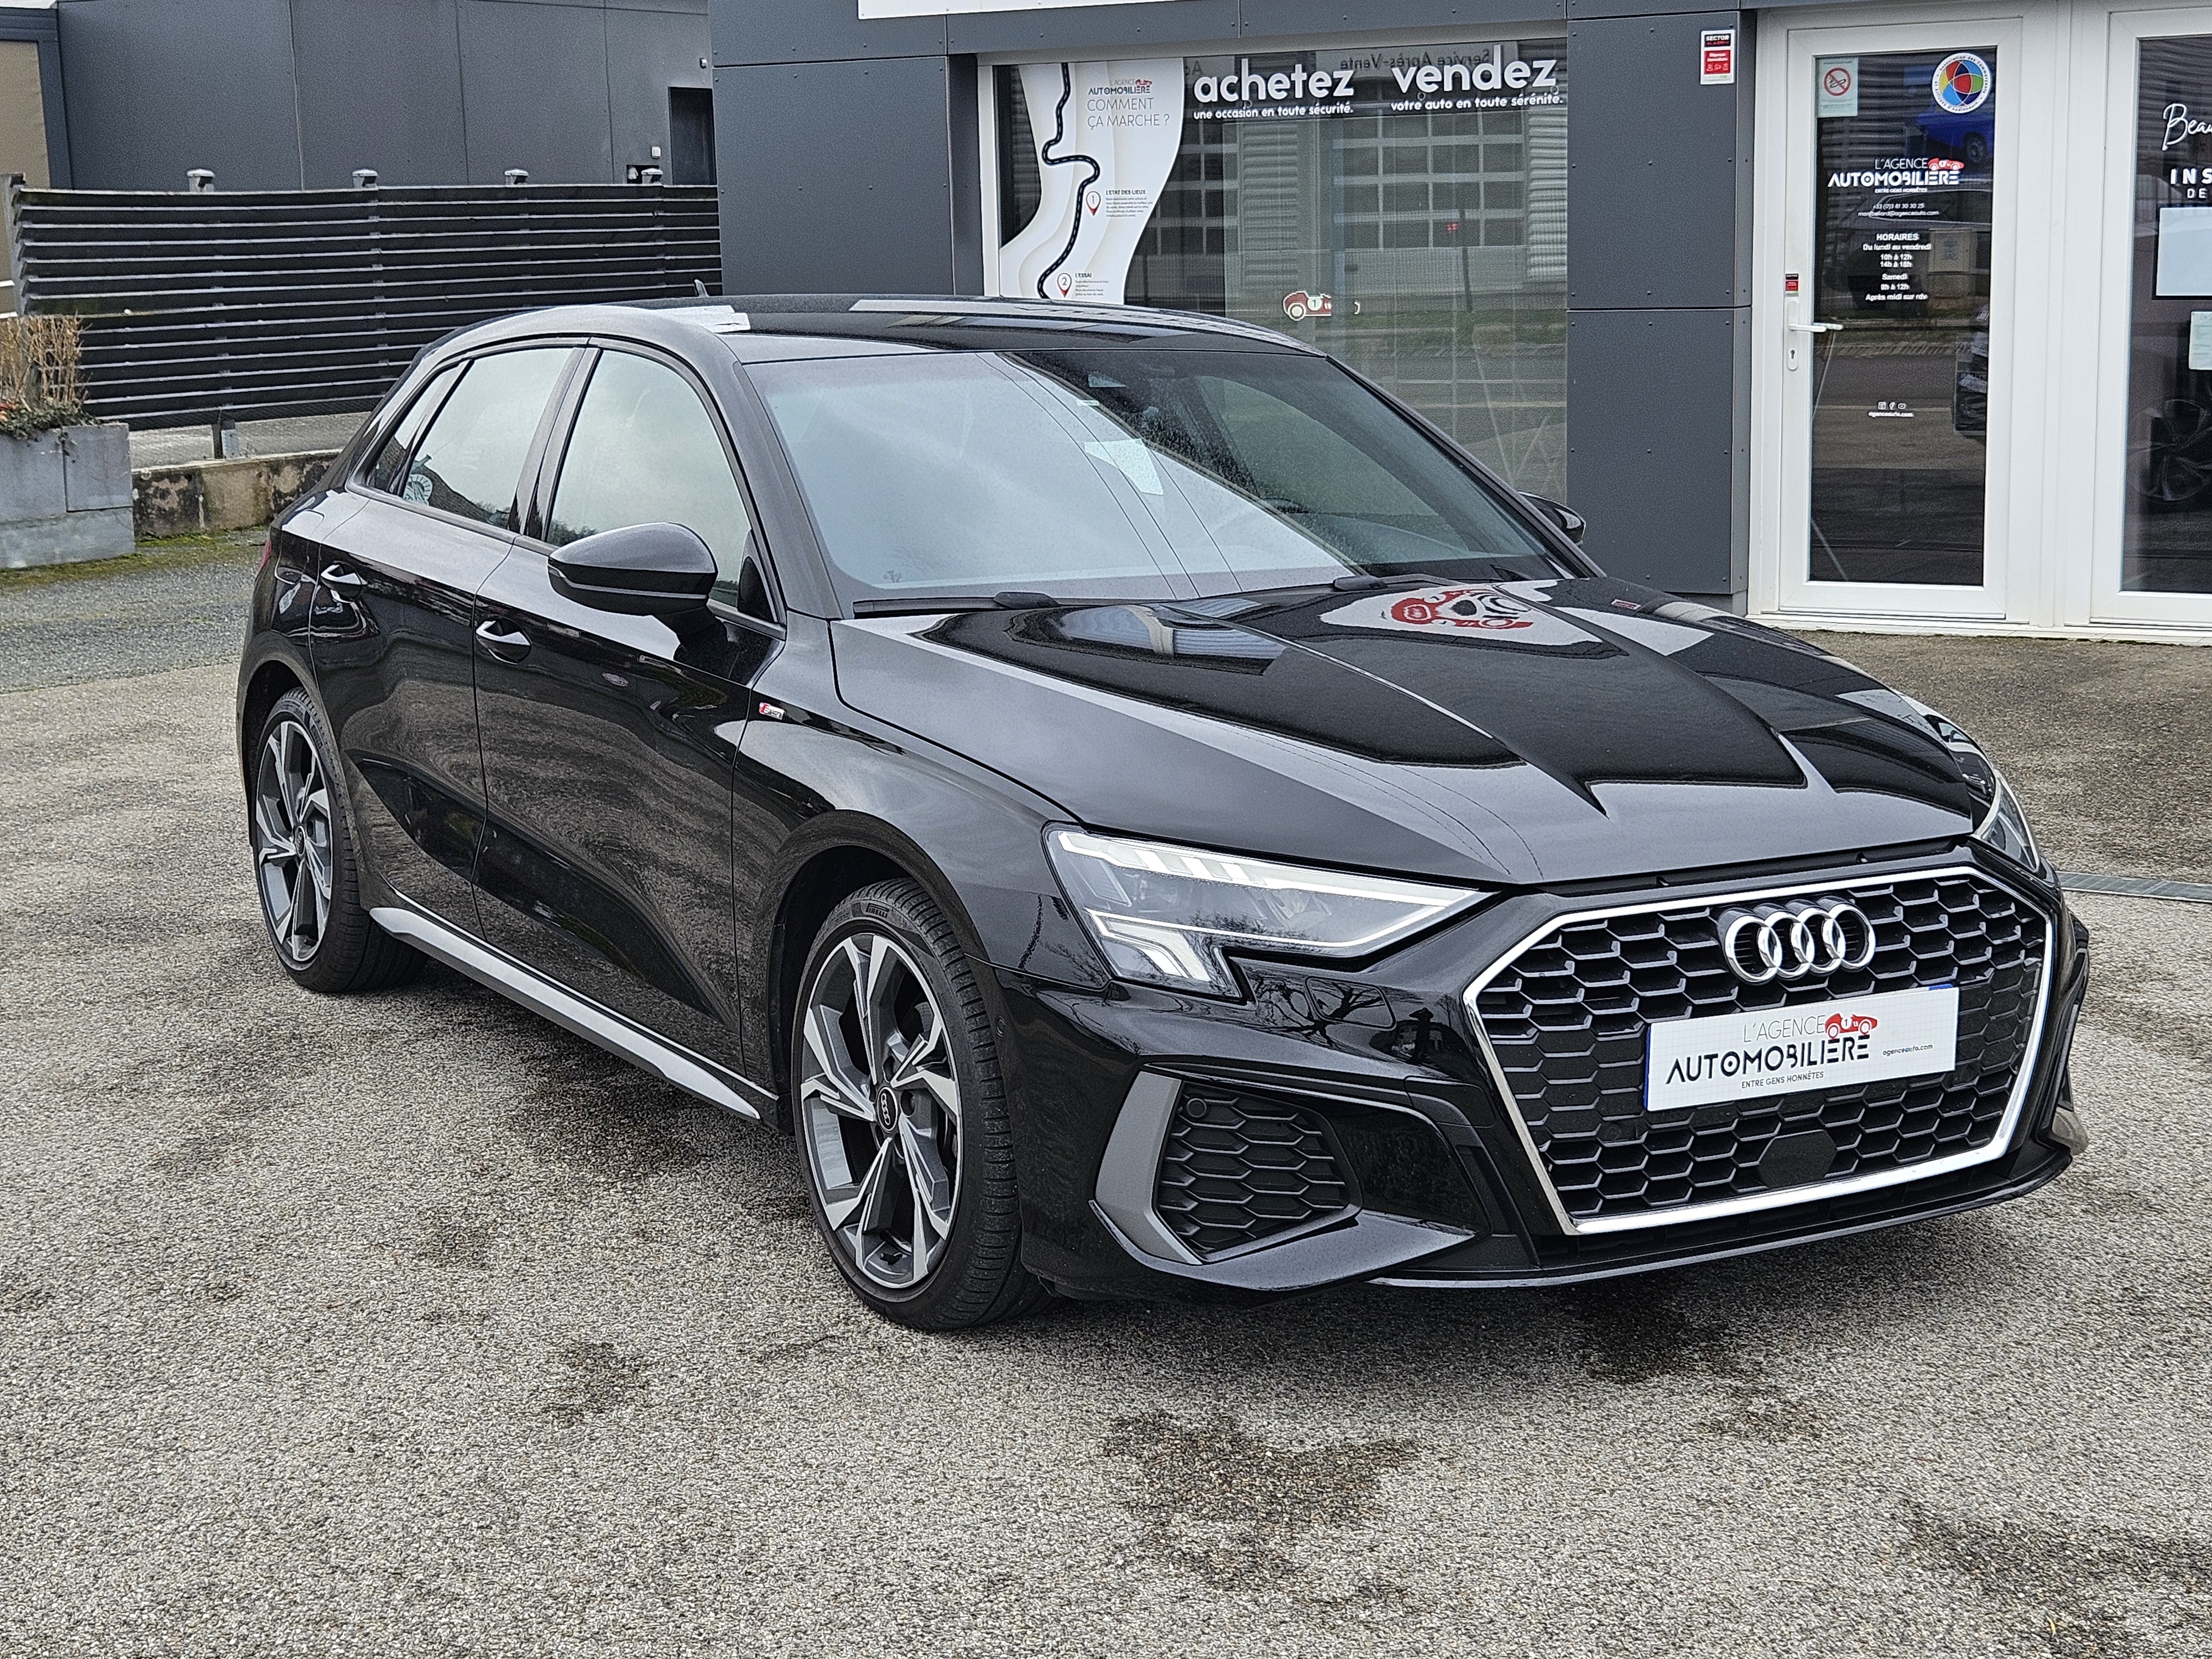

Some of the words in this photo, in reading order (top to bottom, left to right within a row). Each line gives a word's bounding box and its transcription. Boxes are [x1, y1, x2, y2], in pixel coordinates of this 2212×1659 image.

[1391, 44, 1557, 93] vendez
[1194, 58, 1354, 102] achetez
[1087, 97, 1154, 111] COMMENT
[1193, 111, 1213, 119] une
[1215, 107, 1259, 118] occasion
[1261, 108, 1275, 117] en
[1277, 106, 1305, 117] toute
[1308, 101, 1354, 115] sécurité.
[1391, 100, 1422, 111] votre
[1425, 99, 1453, 109] auto
[1456, 99, 1471, 109] en
[1474, 96, 1507, 108] toute
[1511, 92, 1564, 106] sérénité.
[1087, 116, 1104, 130] ÇA
[1107, 114, 1160, 127] MARCHE
[1164, 113, 1170, 126] ?
[1875, 158, 1928, 169] L'AGENCE
[2171, 168, 2212, 185] INS
[2187, 187, 2208, 199] DE
[1062, 277, 1067, 285] 2
[865, 902, 890, 918] PIRELLI
[1744, 1014, 1825, 1042] L'AGENCE
[1741, 1078, 1764, 1089] ENTRE
[1766, 1076, 1785, 1087] GENS
[1786, 1070, 1824, 1084] HONNÊTES
